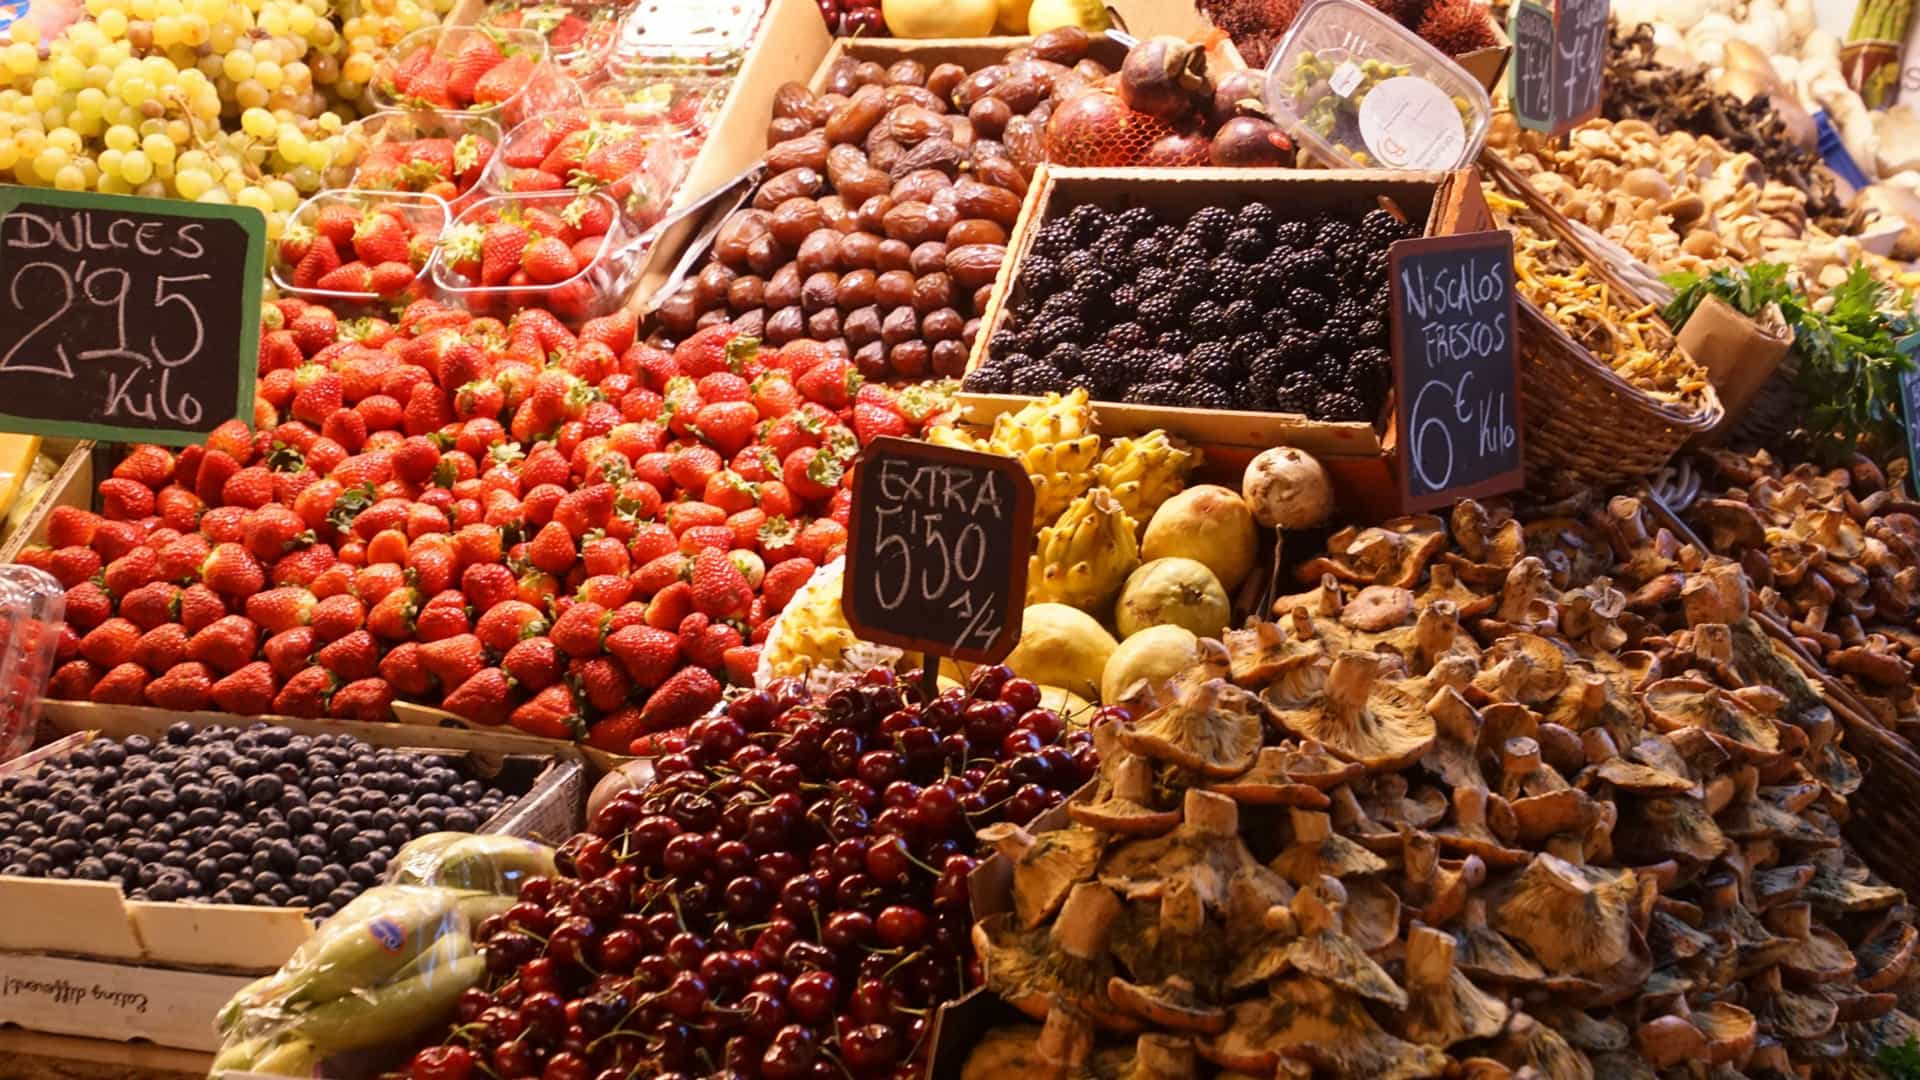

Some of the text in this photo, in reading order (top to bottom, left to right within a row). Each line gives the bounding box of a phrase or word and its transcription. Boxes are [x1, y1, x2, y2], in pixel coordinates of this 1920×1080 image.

[1, 211, 204, 258] DULCES
[0, 260, 211, 379] 2'95
[1422, 312, 1506, 368] FRESCOS
[877, 459, 1003, 520] EXTRA
[875, 504, 987, 611] 5'50
[91, 984, 149, 1014] Eating
